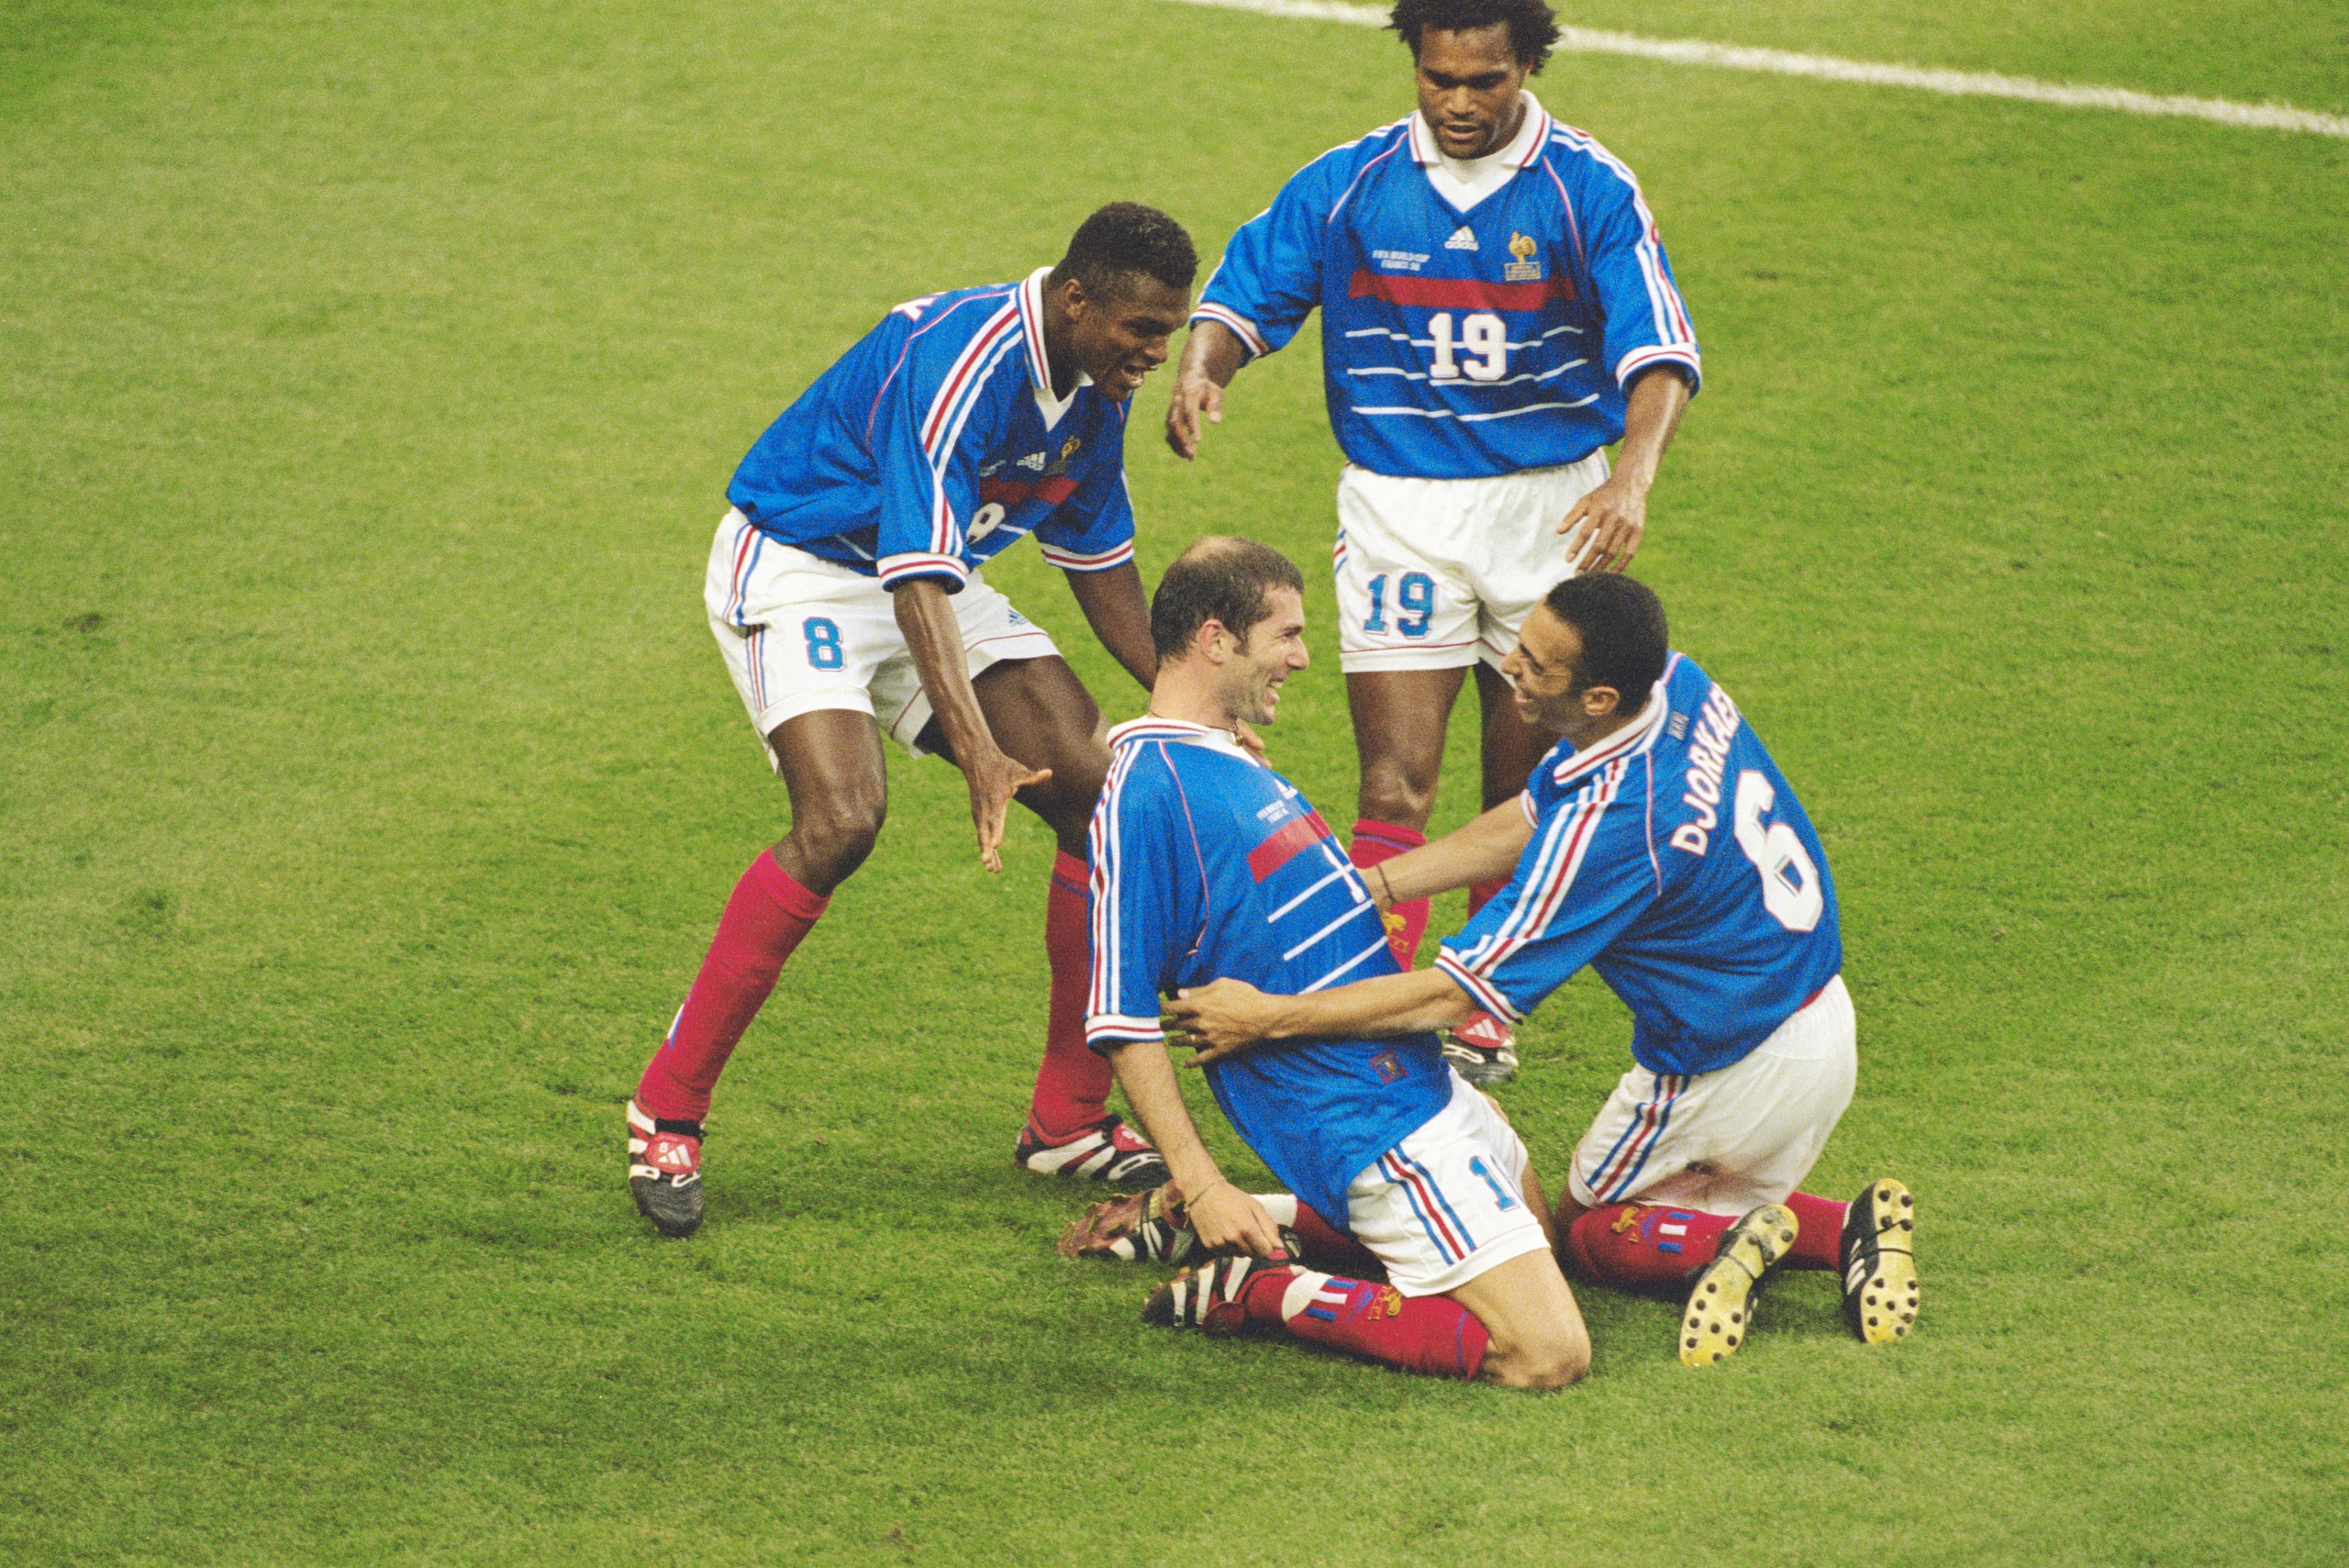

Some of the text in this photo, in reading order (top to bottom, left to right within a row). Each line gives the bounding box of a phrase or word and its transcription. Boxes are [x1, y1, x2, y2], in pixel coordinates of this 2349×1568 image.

[1428, 312, 1507, 381] 19
[1363, 572, 1438, 639] 19
[801, 616, 848, 673] 8
[1733, 769, 1824, 932] 6
